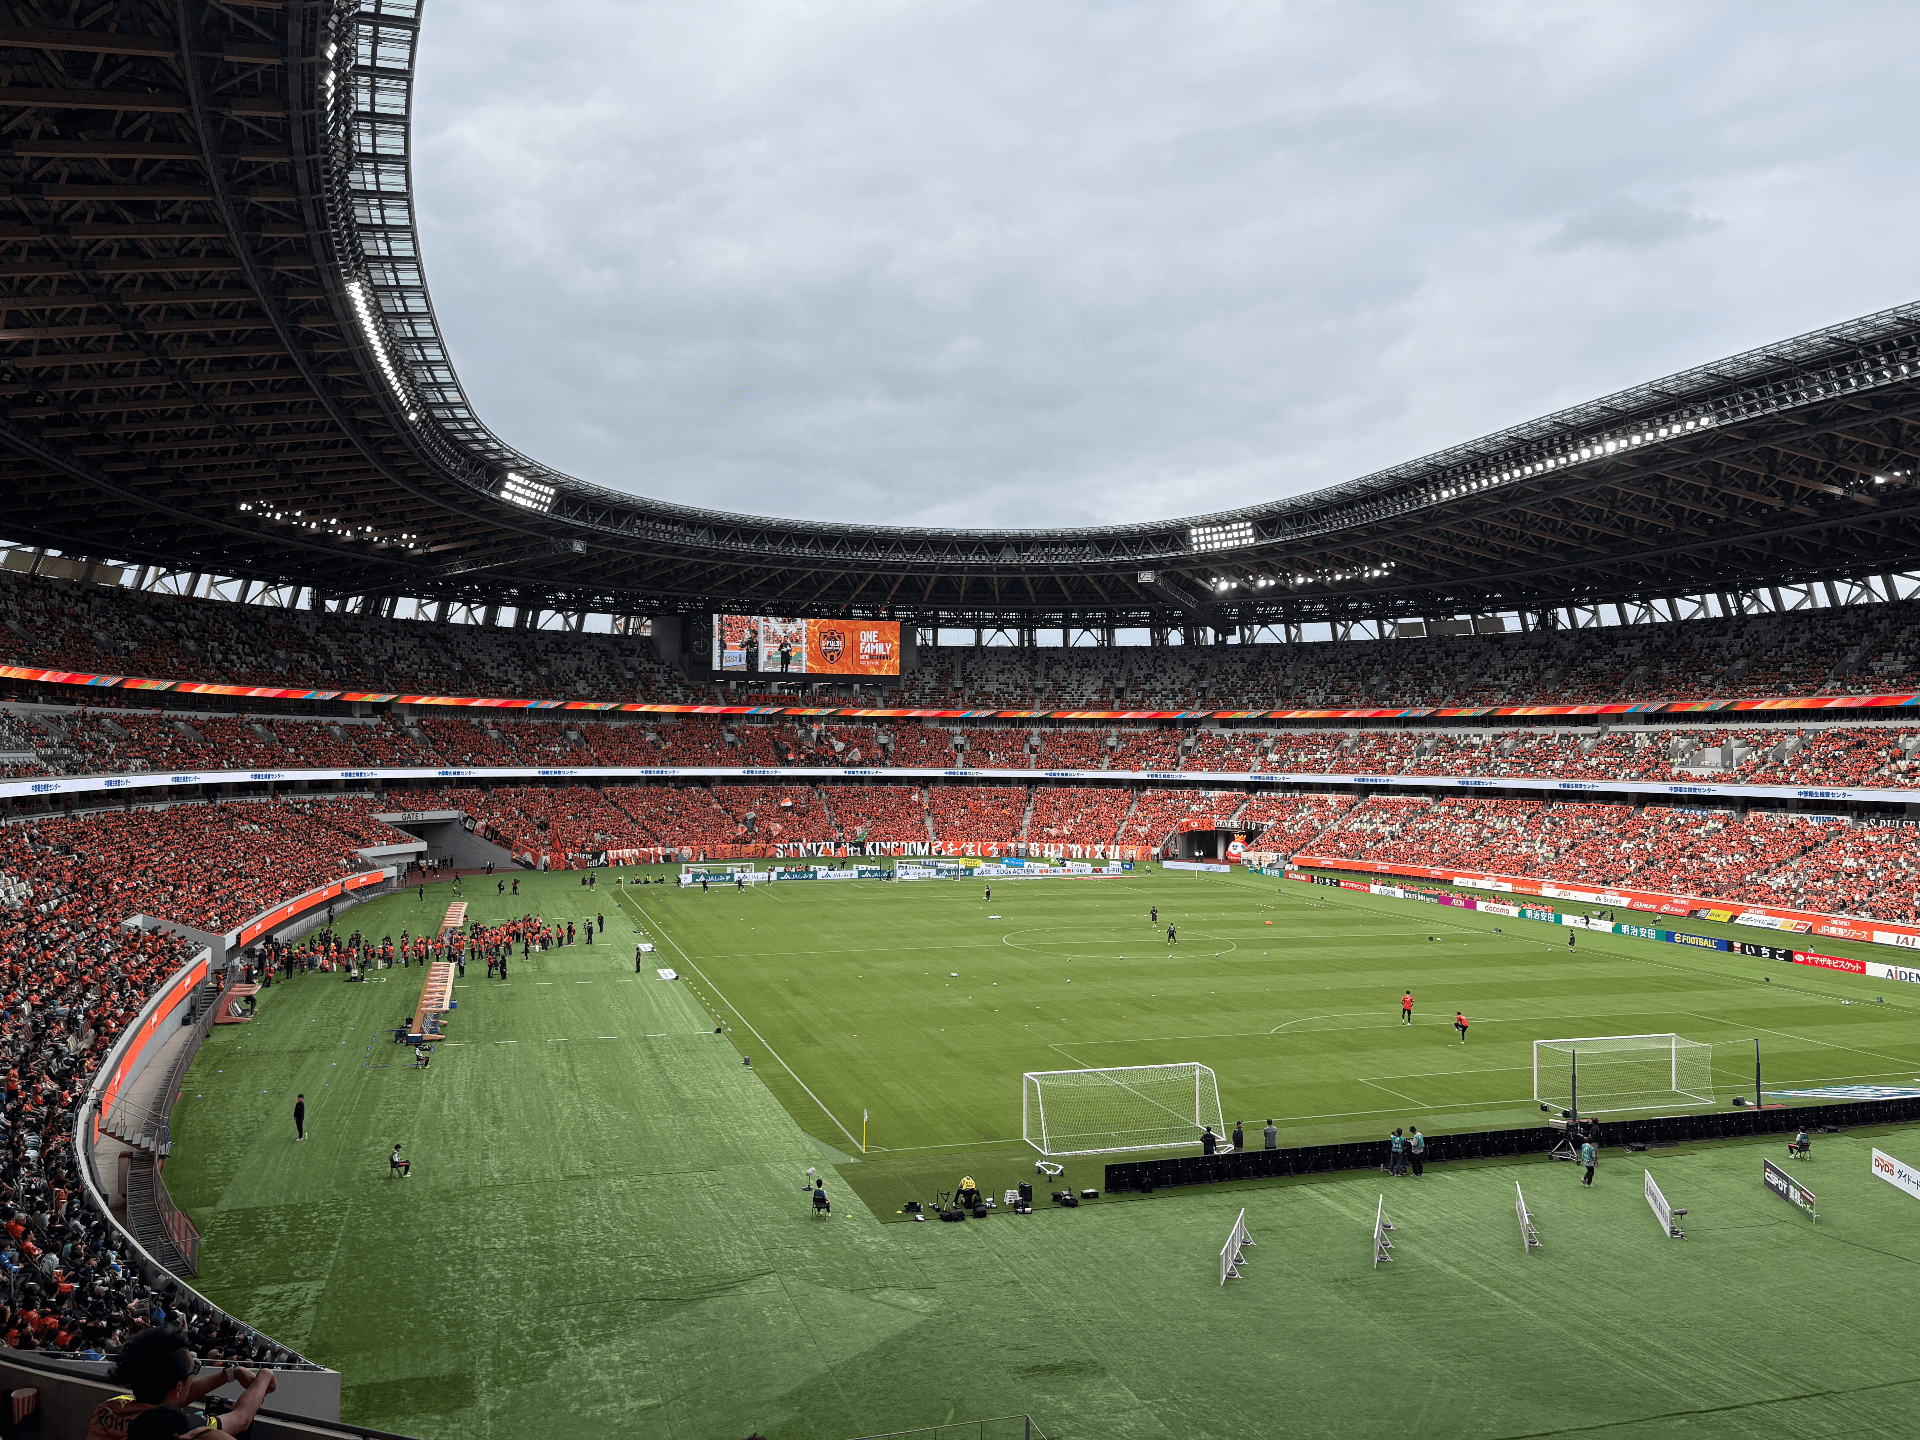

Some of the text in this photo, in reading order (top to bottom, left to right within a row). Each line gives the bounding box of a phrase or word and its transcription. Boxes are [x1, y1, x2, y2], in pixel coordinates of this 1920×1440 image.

[860, 631, 878, 642] ONE
[860, 643, 892, 654] FAMILY
[1485, 905, 1510, 914] docomo
[1526, 909, 1554, 922] 明治安田
[1622, 924, 1656, 939] 明治安田
[1896, 935, 1915, 946] IAI
[1746, 944, 1785, 960] いちご
[1806, 955, 1861, 971] ヤマザキビスケット
[1875, 1158, 1894, 1176] DyDo
